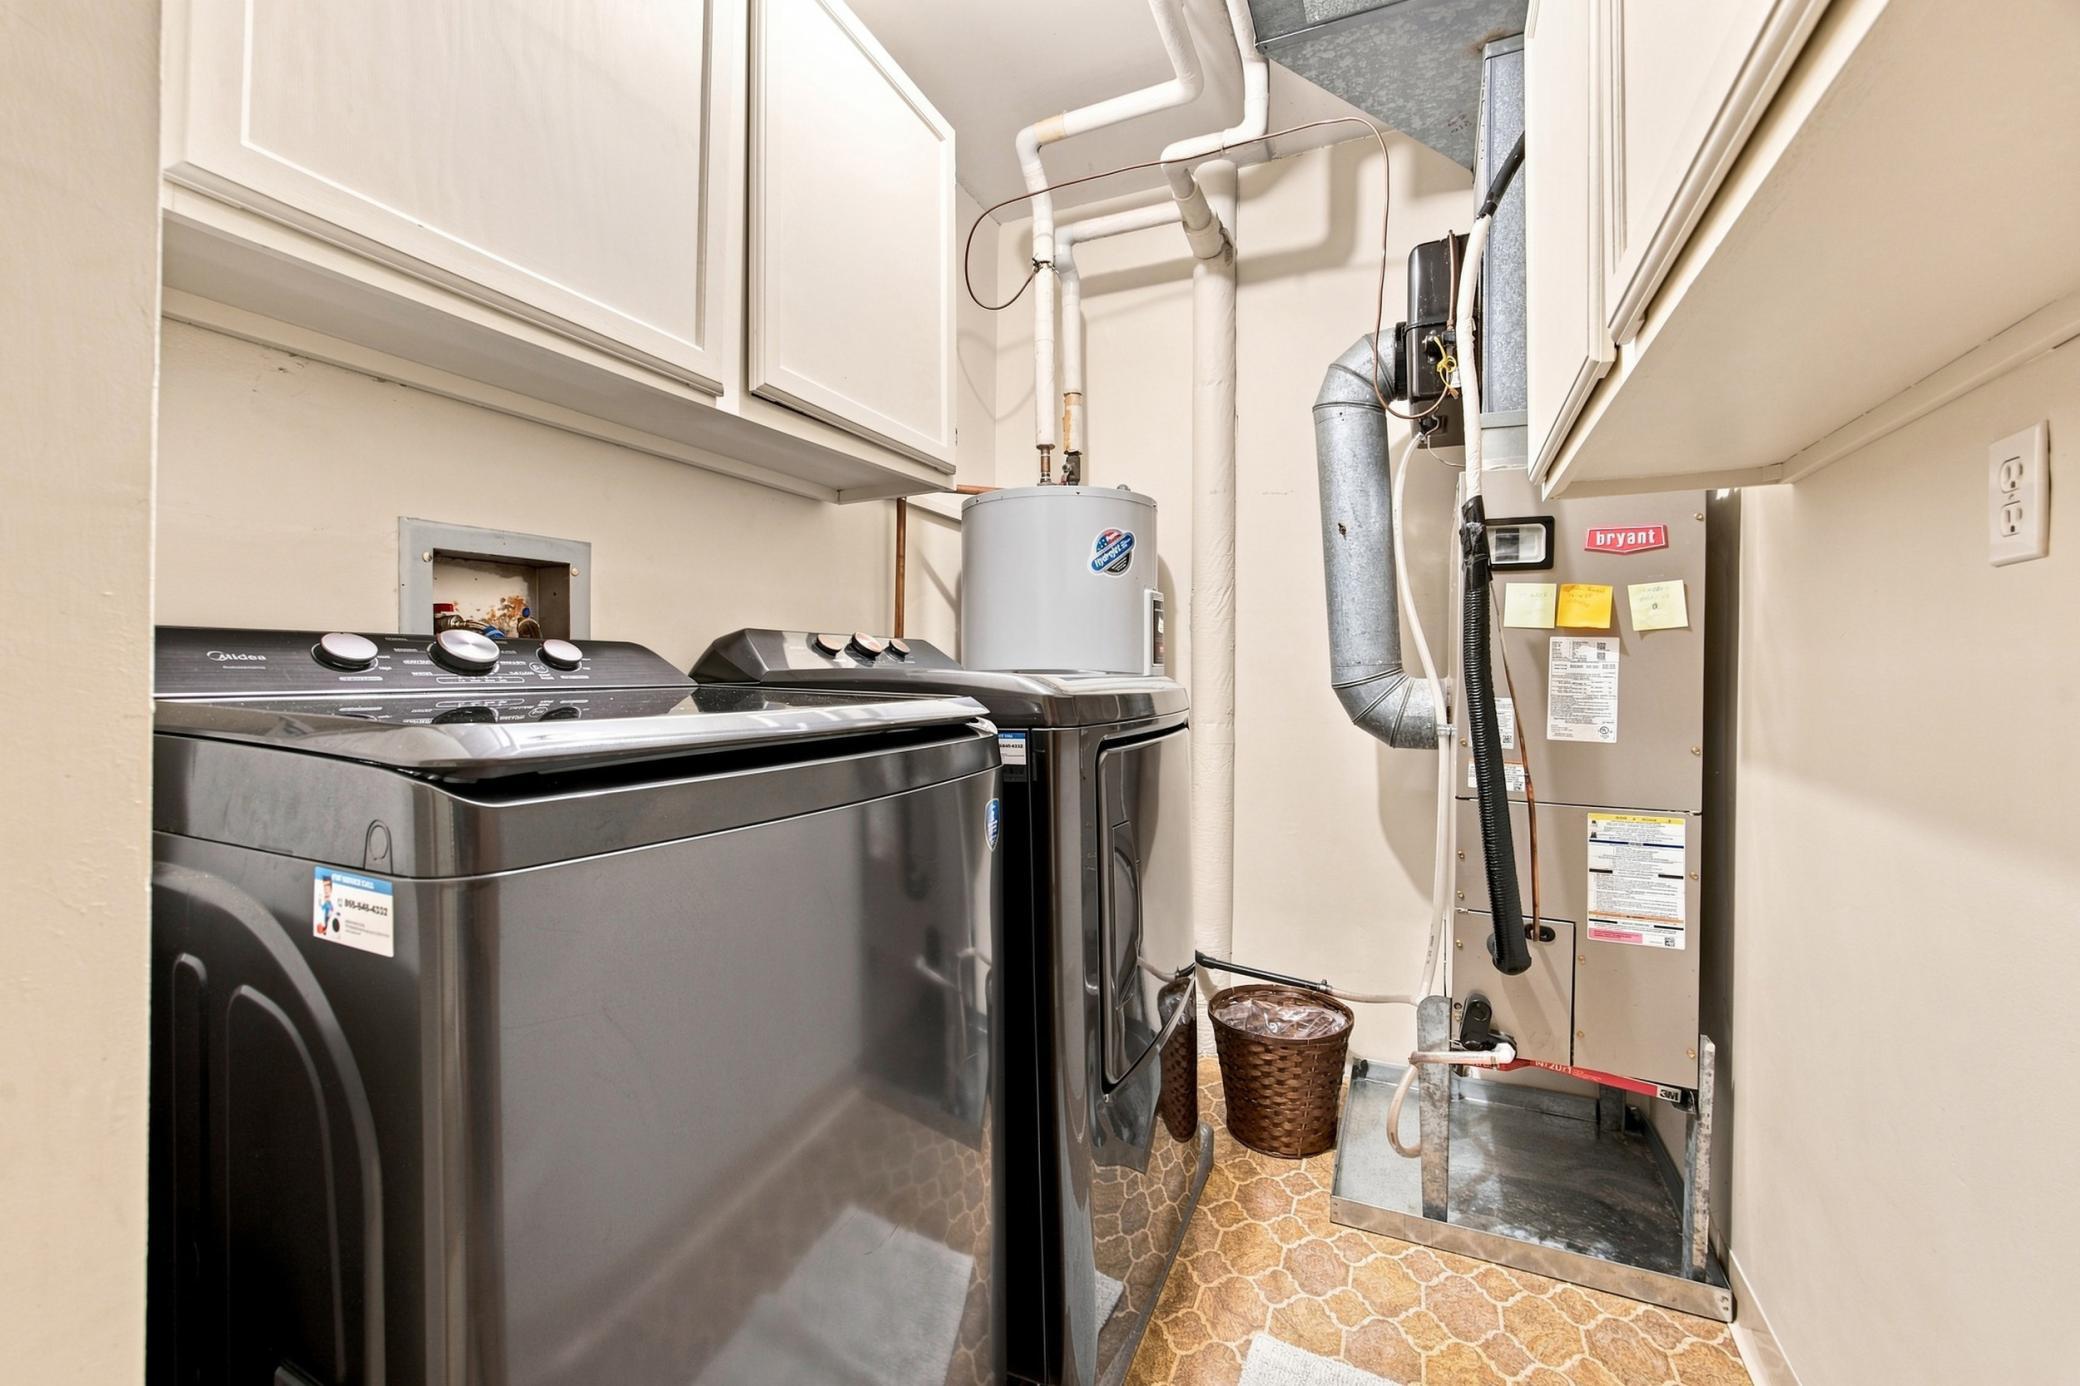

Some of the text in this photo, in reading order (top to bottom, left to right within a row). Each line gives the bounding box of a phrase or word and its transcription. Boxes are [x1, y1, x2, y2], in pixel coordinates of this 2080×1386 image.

[1596, 529, 1655, 548] bryant
[206, 650, 267, 662] Midea
[1660, 1088, 1678, 1101] 3M
